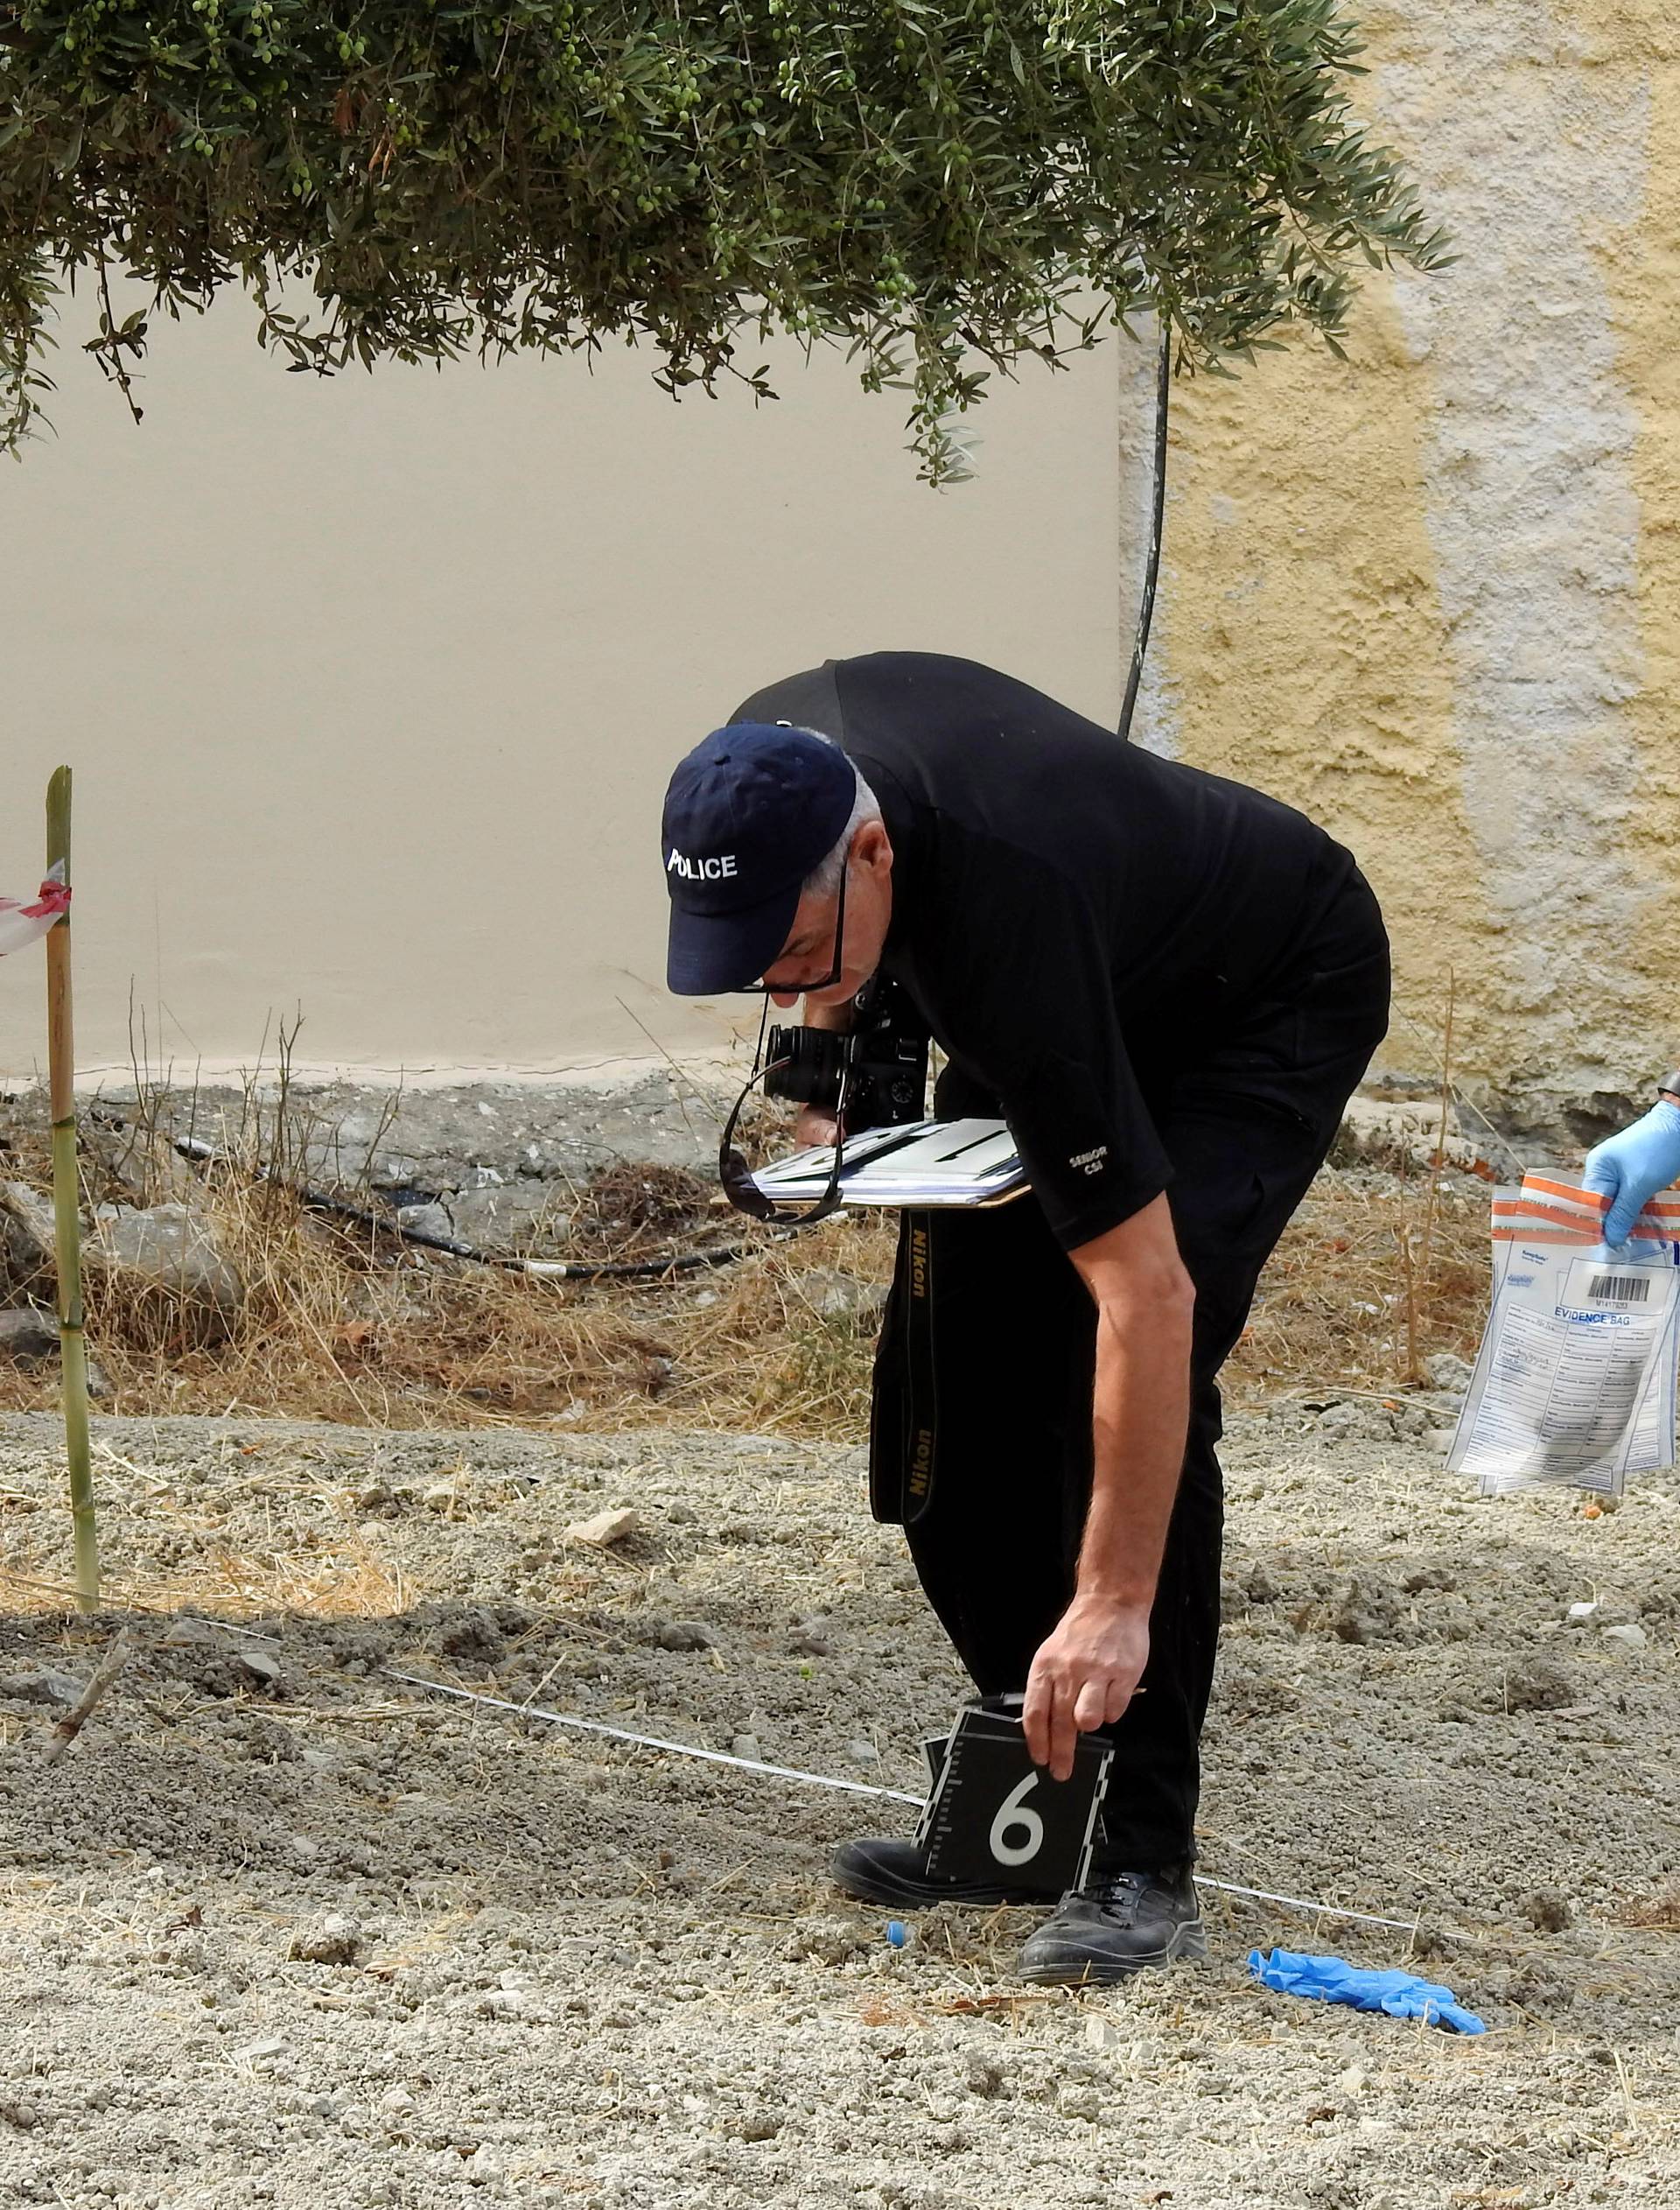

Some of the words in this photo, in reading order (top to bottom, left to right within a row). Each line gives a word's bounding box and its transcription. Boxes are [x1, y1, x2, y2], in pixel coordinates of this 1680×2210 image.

[667, 847, 738, 880] POLICE
[1069, 1146, 1108, 1168] SENIOR
[1084, 1160, 1103, 1175] CSI
[913, 1229, 927, 1297] Nikon
[1554, 1306, 1607, 1324] EVIDENCE
[1610, 1315, 1630, 1325] BAG
[908, 1428, 932, 1496] Nikon
[989, 1770, 1044, 1866] 6
